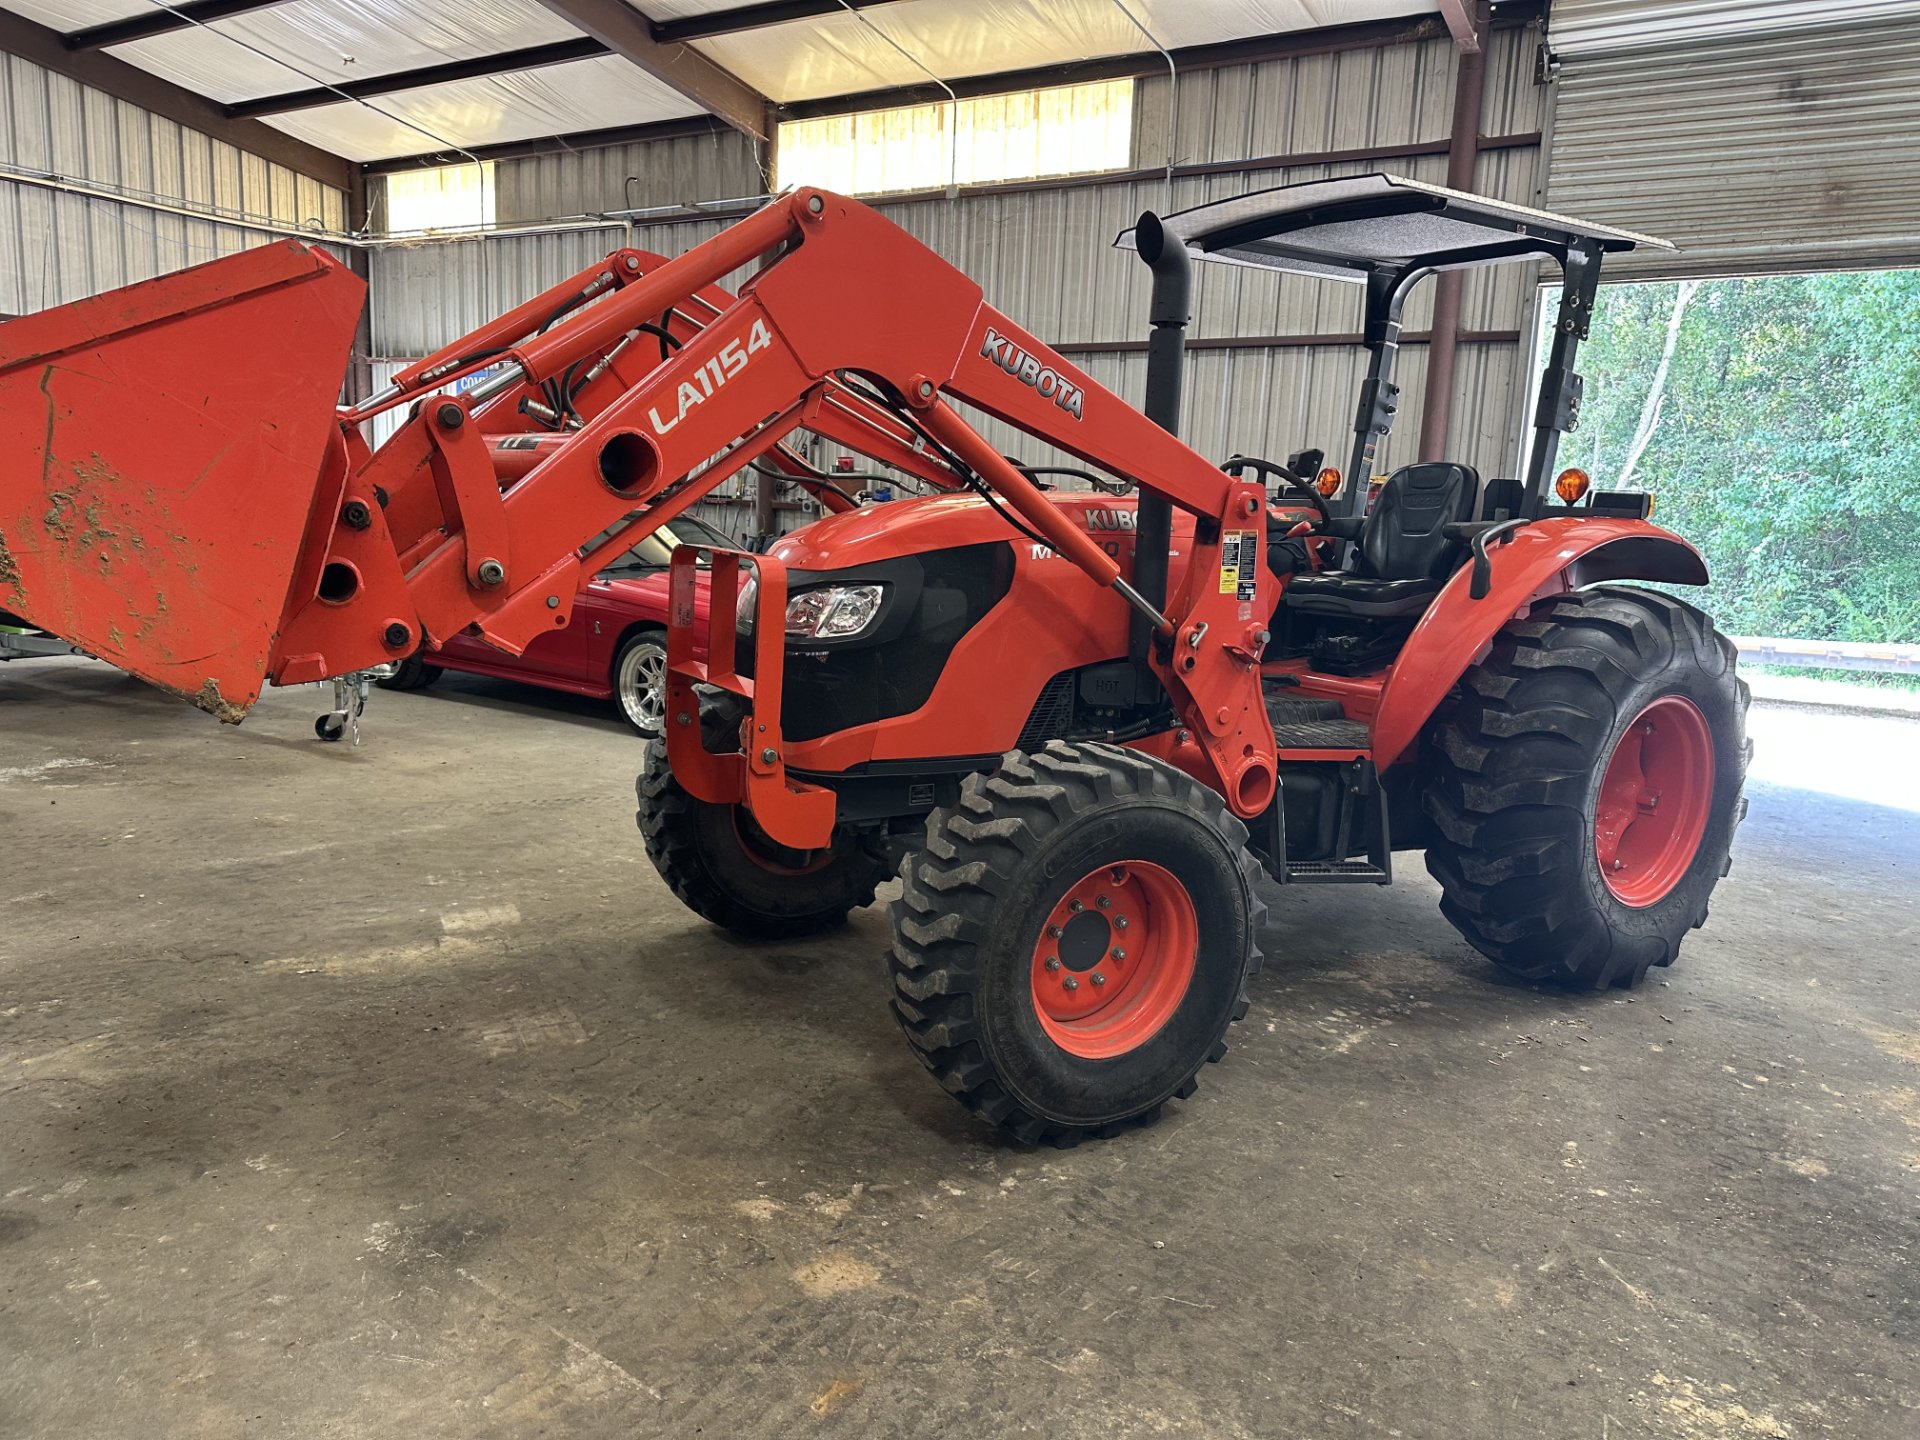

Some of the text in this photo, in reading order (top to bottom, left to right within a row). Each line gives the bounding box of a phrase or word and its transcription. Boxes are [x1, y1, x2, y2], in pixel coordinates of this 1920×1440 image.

[648, 317, 772, 435] LA1154
[980, 328, 1083, 420] KUBOTA
[1096, 679, 1120, 695] HOT
